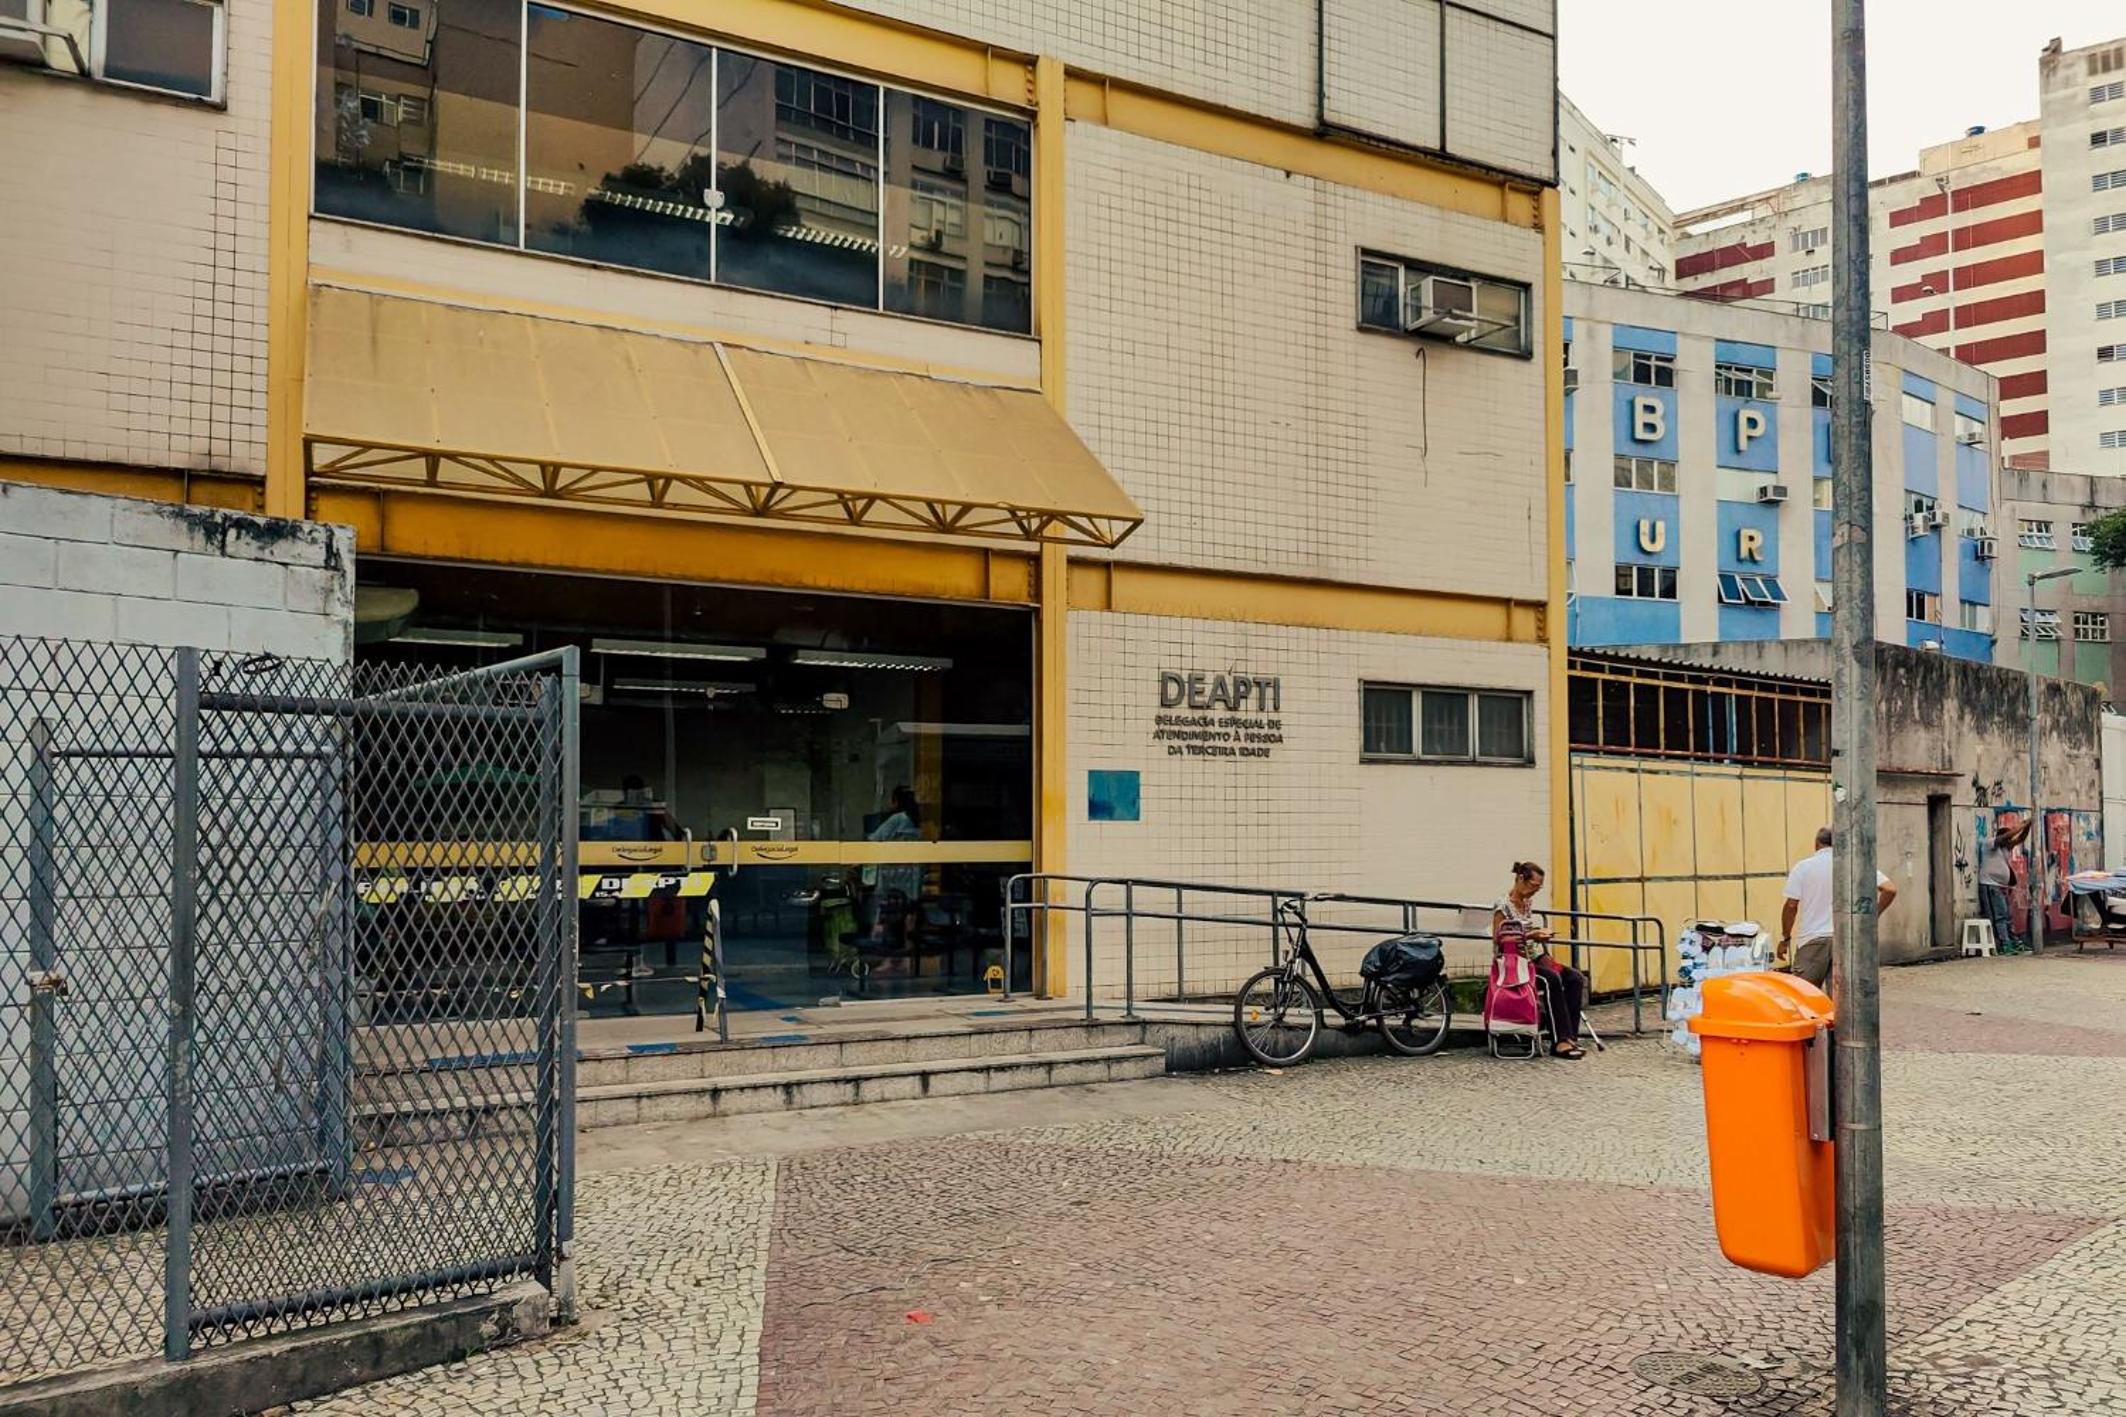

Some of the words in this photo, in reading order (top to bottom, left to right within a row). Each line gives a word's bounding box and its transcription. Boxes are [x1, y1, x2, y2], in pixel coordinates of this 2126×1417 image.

[1634, 396, 1666, 442] B
[1736, 408, 1767, 453] P
[1638, 518, 1666, 553] U
[1738, 527, 1764, 562] R
[1160, 671, 1281, 711] DEAPTI
[1154, 715, 1215, 728] DELEGACIA
[1218, 716, 1264, 729] ESPECIAL
[1267, 719, 1281, 730] DE
[1152, 729, 1231, 742] ATENDIMENTO
[1244, 732, 1284, 744] PESSOA
[1167, 744, 1183, 755] DA
[1185, 744, 1237, 757] TERCEIRA
[1239, 746, 1271, 758] IDADE
